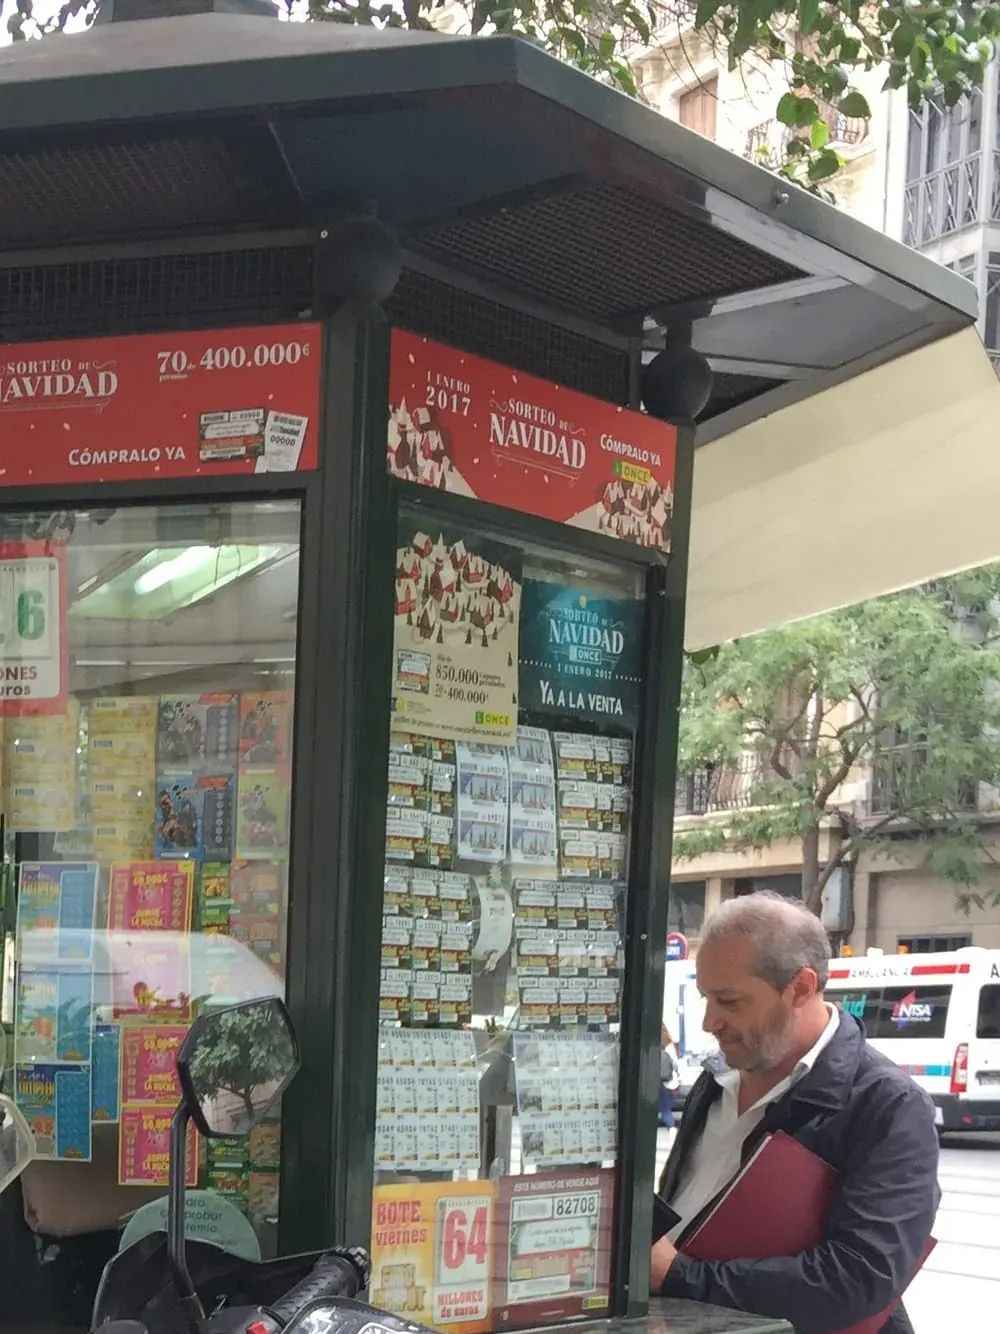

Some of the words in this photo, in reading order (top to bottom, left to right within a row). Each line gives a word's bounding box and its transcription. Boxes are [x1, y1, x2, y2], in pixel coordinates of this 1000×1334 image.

[6, 358, 72, 375] SORTEO
[157, 351, 187, 374] 70
[200, 341, 310, 370] 400.000€
[436, 374, 470, 394] ENERO
[426, 385, 471, 417] 2017
[507, 397, 556, 426] SORTEO
[489, 413, 586, 470] NAVIDAD
[600, 432, 651, 462] CÓMPRALO
[650, 453, 661, 468] YA
[68, 447, 161, 465] CÓMPRALO
[165, 446, 186, 461] YA
[624, 466, 650, 483] ONCE
[549, 618, 624, 654] NAVIDAD
[579, 649, 600, 661] ONCE
[436, 664, 479, 685] 850.000
[564, 664, 591, 676] ENERO
[540, 680, 554, 706] YA
[557, 689, 565, 707] A
[569, 691, 585, 710] LA
[588, 693, 623, 716] VENTA
[485, 714, 509, 726] ONCE
[185, 1198, 206, 1208] ara
[376, 1200, 421, 1226] BOTE
[556, 1196, 596, 1216] 82708
[160, 1211, 223, 1223] cprobar
[376, 1228, 427, 1246] viernes
[443, 1206, 488, 1270] 64
[437, 1290, 484, 1306] MILLONES
